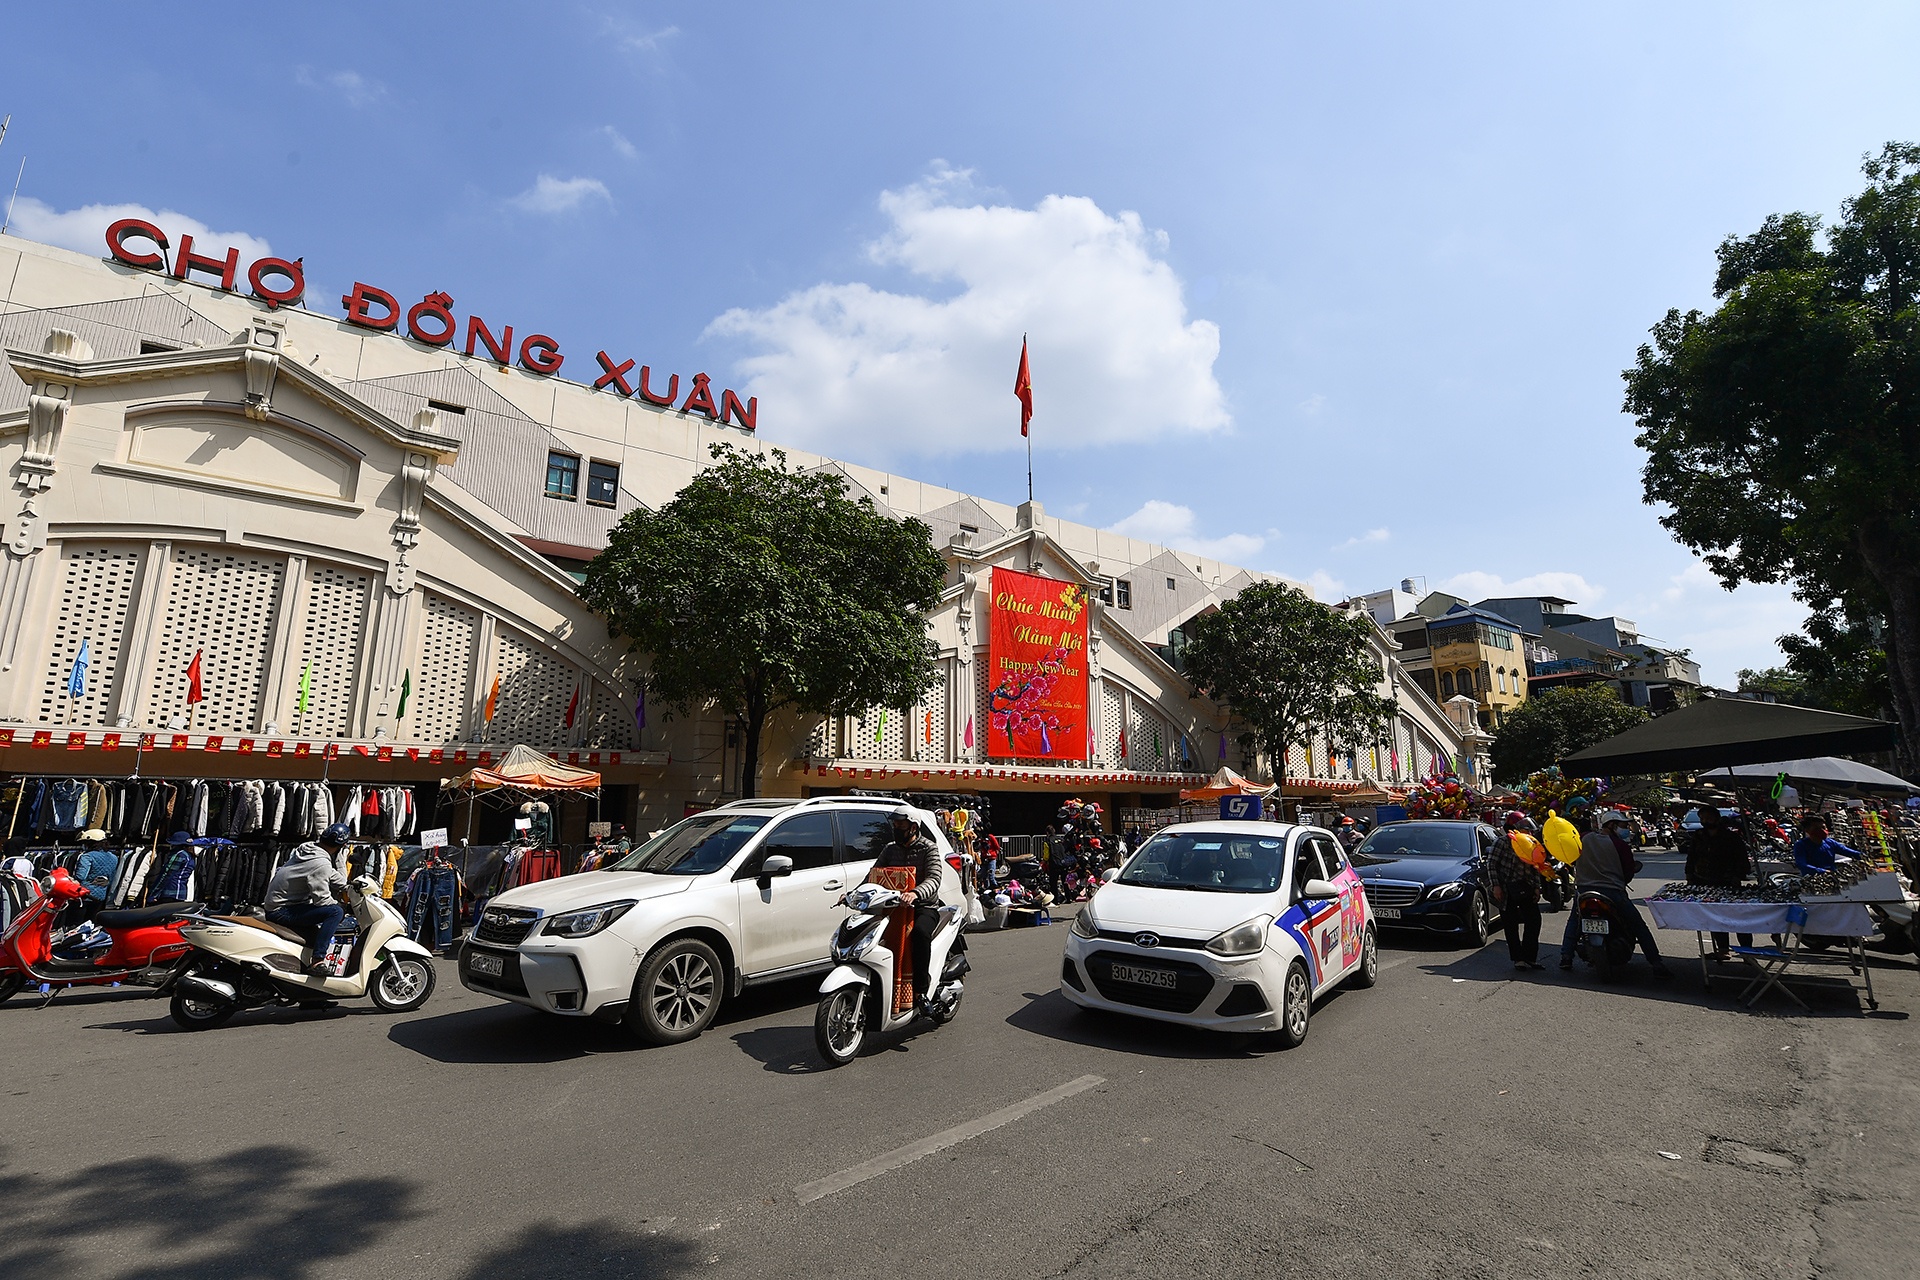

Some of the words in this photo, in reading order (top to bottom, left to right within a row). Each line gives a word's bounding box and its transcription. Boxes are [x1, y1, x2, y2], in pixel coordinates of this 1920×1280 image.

[106, 219, 305, 309] CHỢ
[342, 281, 564, 374] ĐỒNG
[593, 350, 758, 430] XUÂN
[996, 592, 1034, 614] Chúc
[1036, 600, 1077, 625] Mừng
[1014, 624, 1053, 646] Năm
[1056, 631, 1082, 650] Mới
[1000, 657, 1034, 675] Happy
[1036, 661, 1058, 673] New
[1060, 663, 1079, 676] Year
[1229, 798, 1249, 818] G7
[1113, 965, 1175, 988] 30A-252.59
